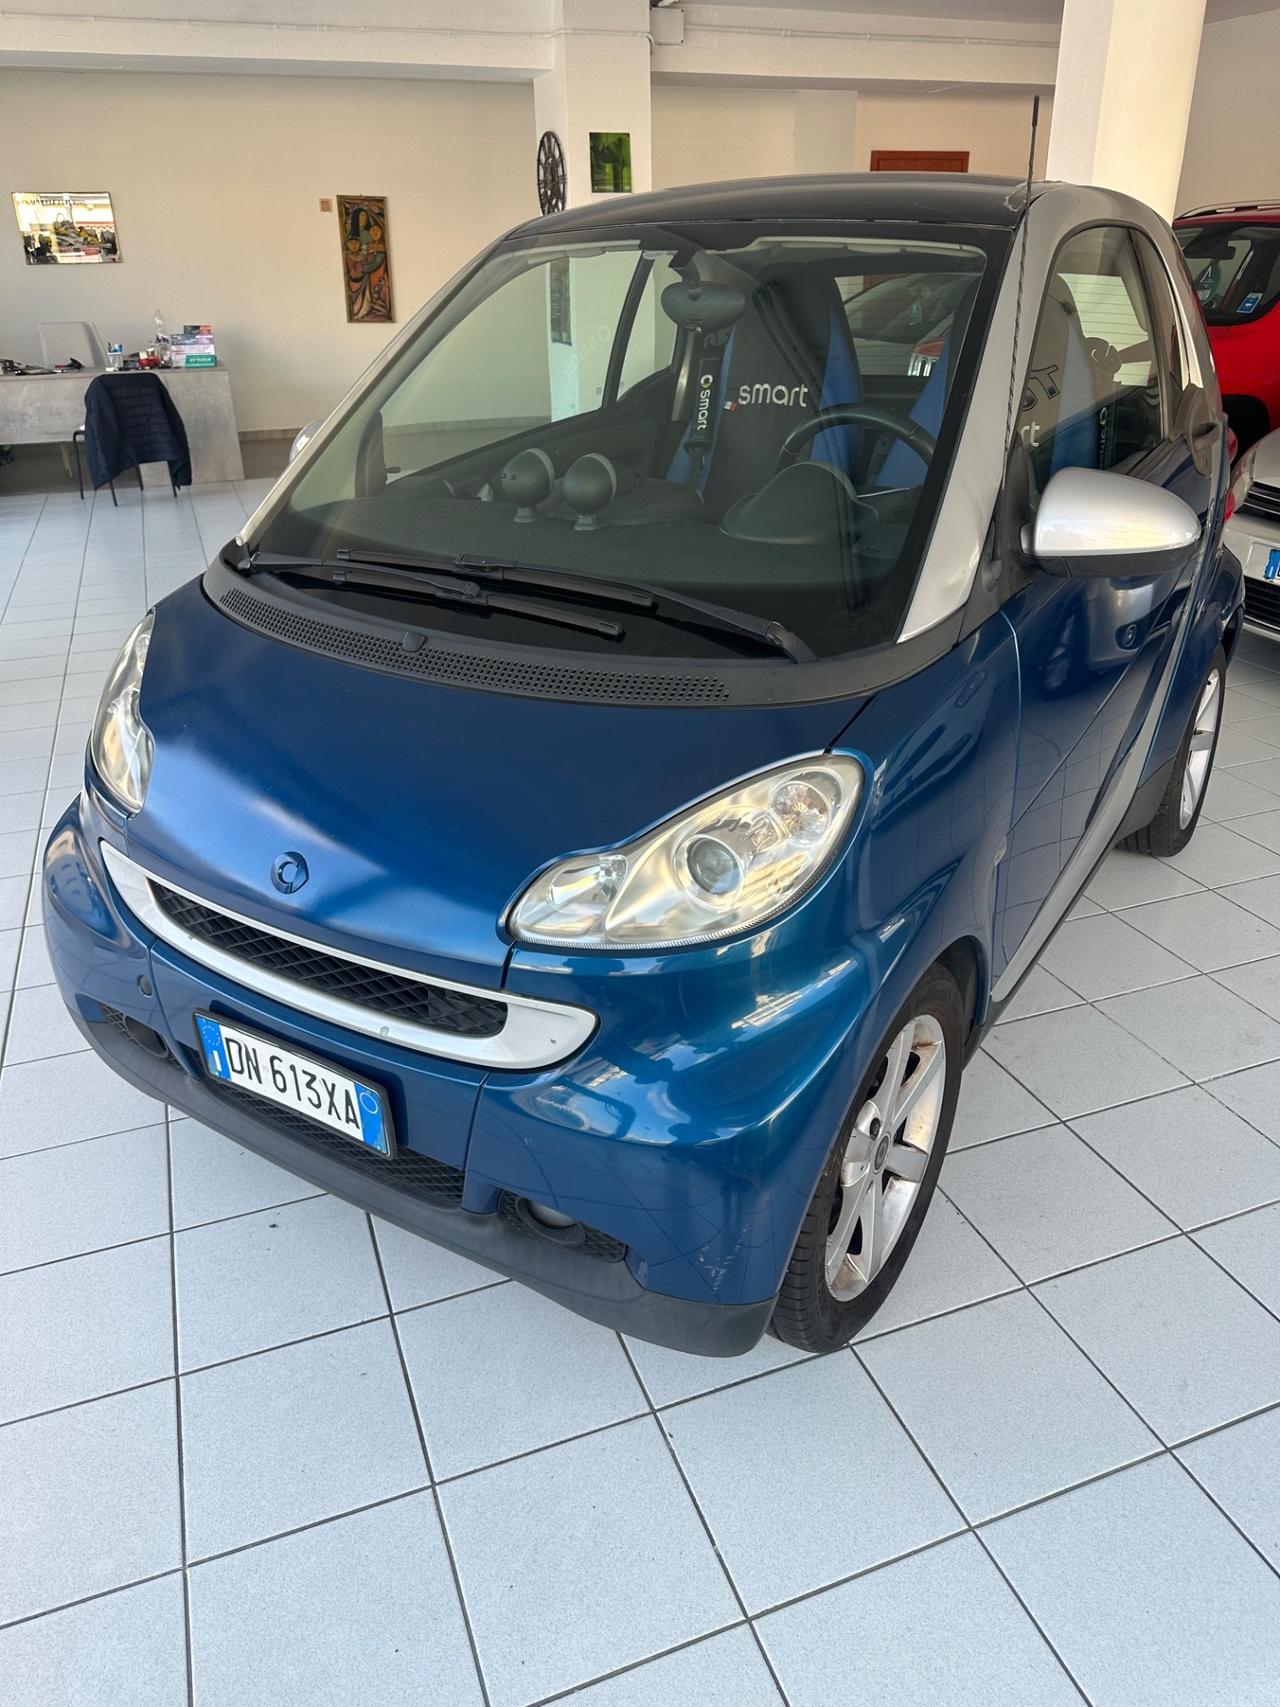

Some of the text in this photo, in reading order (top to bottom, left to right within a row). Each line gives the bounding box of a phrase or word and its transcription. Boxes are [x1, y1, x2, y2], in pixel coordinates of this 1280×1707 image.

[697, 389, 711, 430] smart
[738, 383, 808, 407] smart
[225, 1037, 360, 1129] DN 613XA
